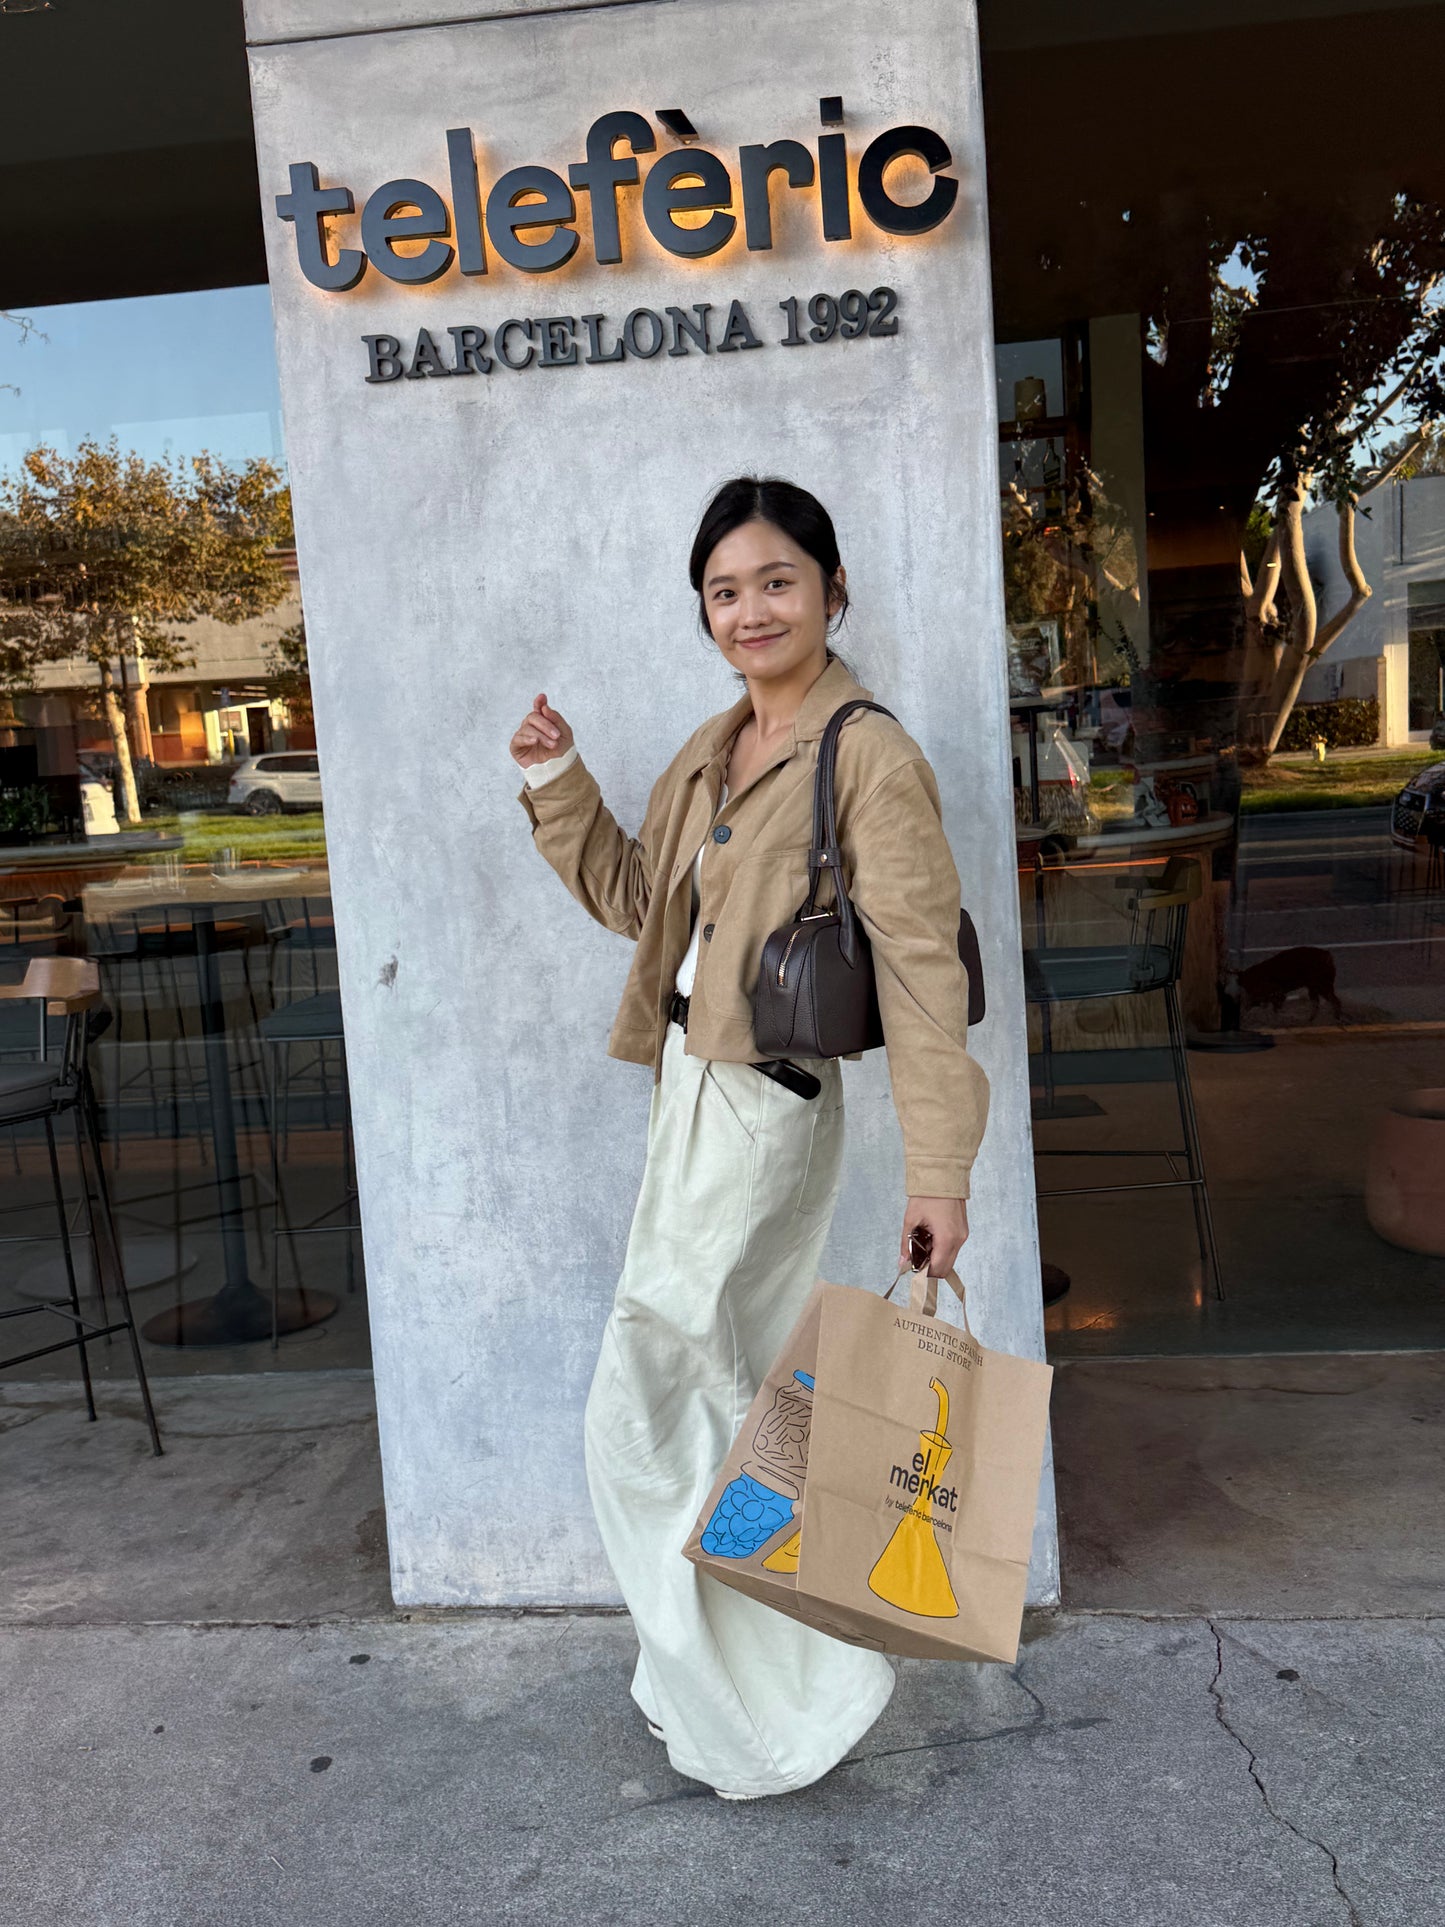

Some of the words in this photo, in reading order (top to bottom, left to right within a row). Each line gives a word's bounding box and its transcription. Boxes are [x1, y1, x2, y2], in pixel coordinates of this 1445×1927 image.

[275, 96, 959, 292] telefèric
[361, 299, 764, 383] BARCELONA
[779, 286, 899, 347] 1992
[893, 1317, 959, 1348] AUTHENTIC
[918, 1338, 945, 1357] DELI
[912, 1448, 932, 1475] el
[889, 1464, 958, 1512] merkat
[884, 1494, 894, 1508] by
[921, 1510, 953, 1533] barcelona
